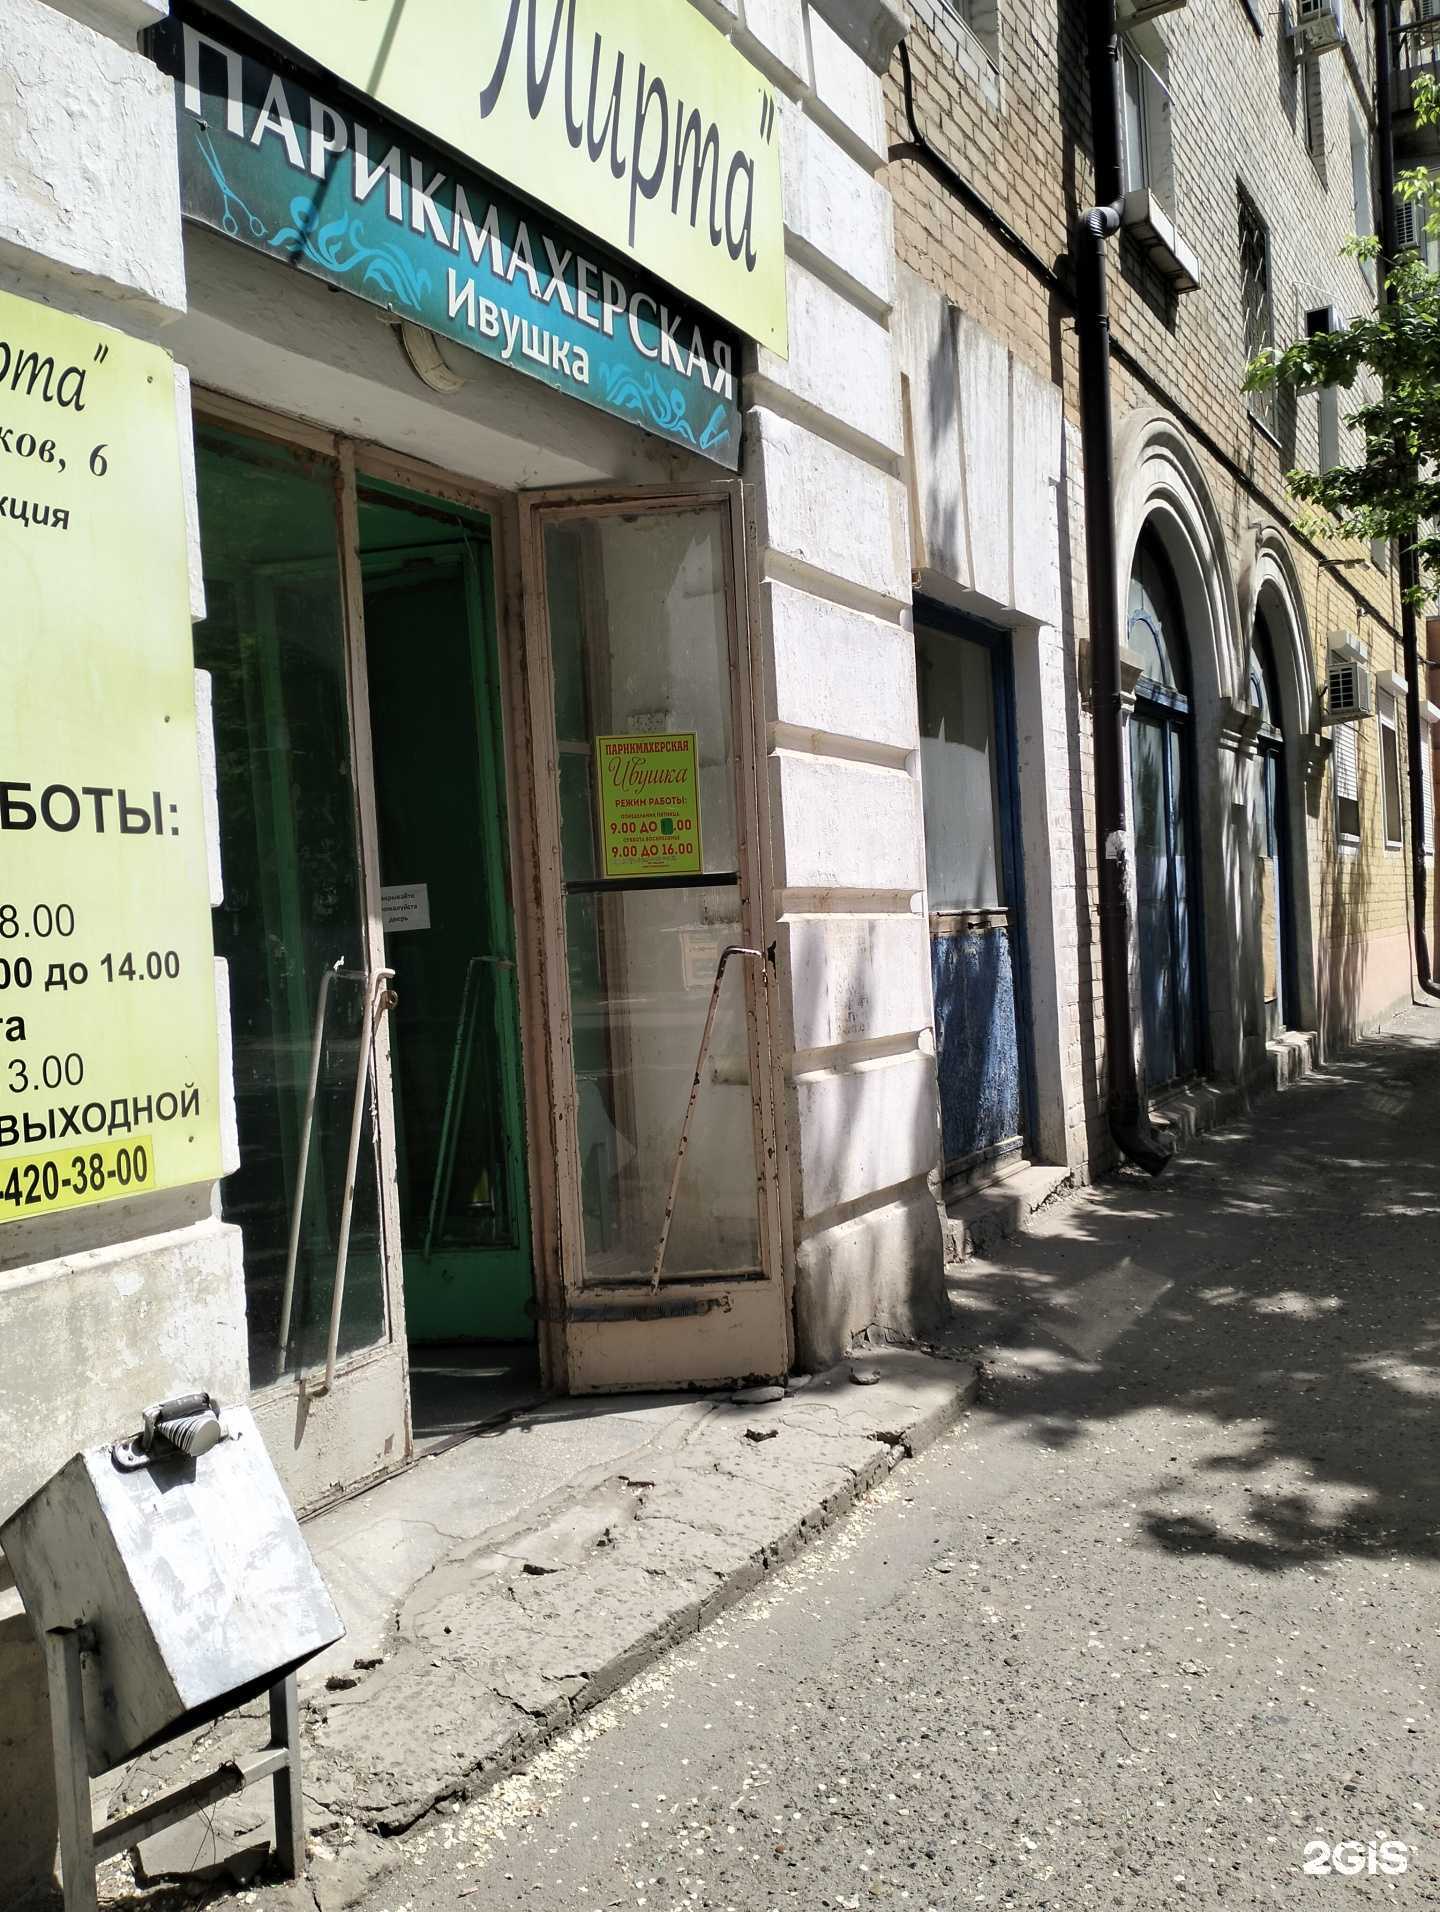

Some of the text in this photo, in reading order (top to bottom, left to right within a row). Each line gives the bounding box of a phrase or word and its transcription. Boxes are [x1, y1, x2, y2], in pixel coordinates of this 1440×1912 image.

[182, 23, 734, 401] ПАРИКМАХЕРСКАЯ
[446, 266, 591, 385] Ивушка
[89, 444, 109, 477] 6
[606, 741, 688, 755] ПАРИКМАХЕРСКАЯ
[608, 756, 688, 795] Ивушка
[0, 781, 179, 836] БОТЫ:
[615, 799, 646, 808] РЕЖИМ
[610, 822, 636, 834] 9.00
[640, 821, 657, 833] ДО
[611, 843, 692, 858] 9.00 ДО 16.00
[0, 903, 75, 938] 8.00
[44, 961, 89, 992] до
[100, 950, 180, 983] 14.00
[0, 1015, 27, 1042] а
[7, 1052, 84, 1094] 3.00
[0, 1081, 200, 1147] ВЫХОДНОЙ
